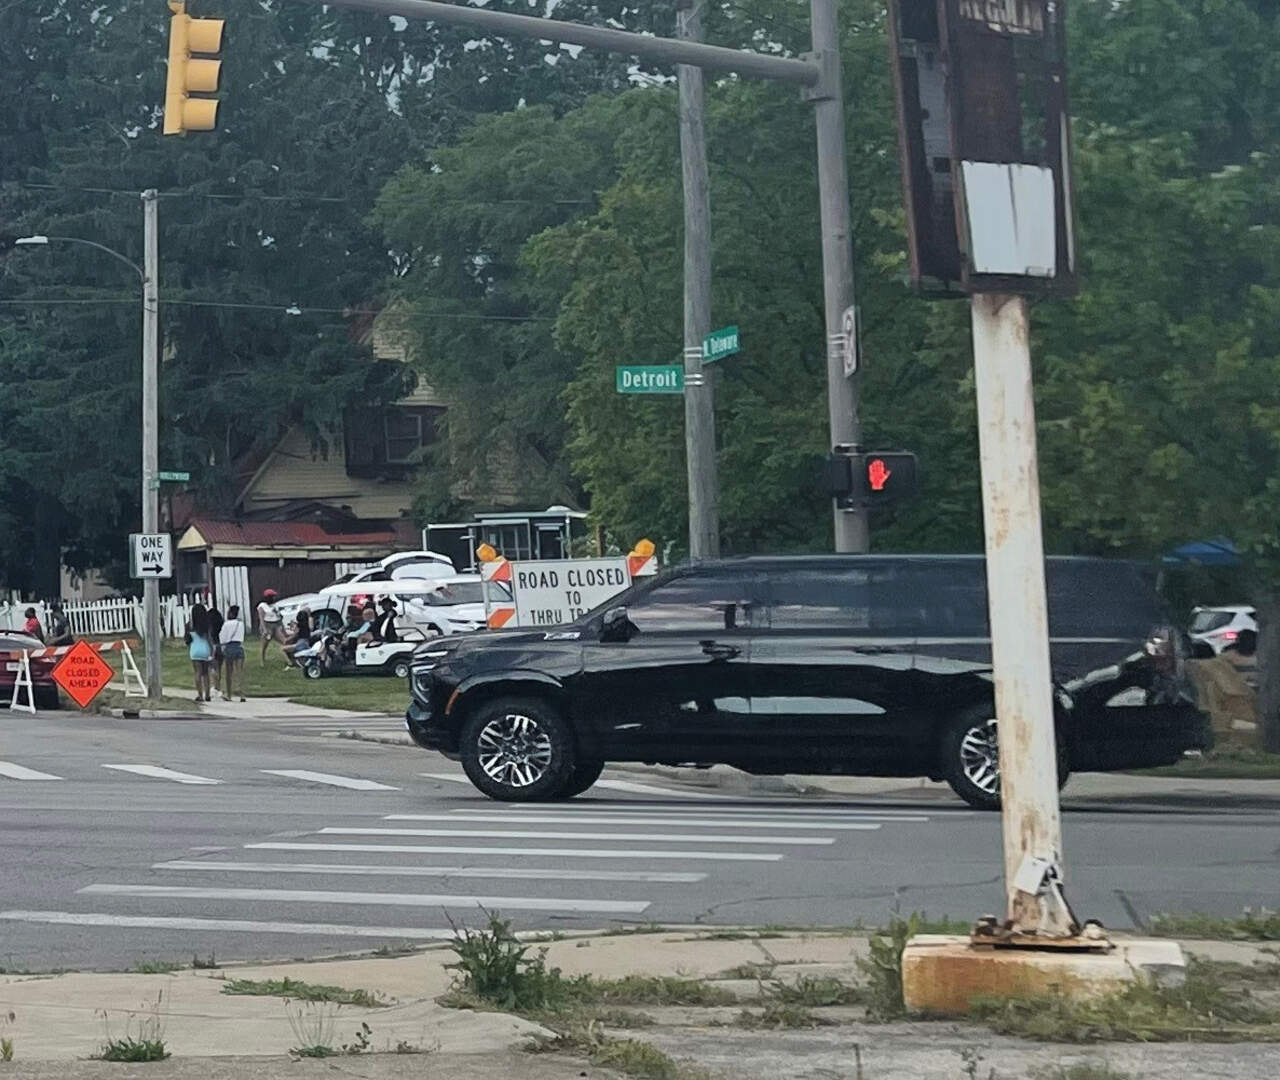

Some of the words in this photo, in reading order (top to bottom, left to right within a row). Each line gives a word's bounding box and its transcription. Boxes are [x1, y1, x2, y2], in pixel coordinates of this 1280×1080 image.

[623, 370, 677, 387] Detroit
[141, 537, 164, 548] ONE
[142, 552, 164, 563] WAY
[519, 570, 559, 589] ROAD
[567, 568, 624, 587] CLOSED
[566, 591, 581, 605] TO
[530, 609, 562, 625] THRU
[70, 656, 95, 664] ROAD
[65, 668, 100, 677] CLOSED
[69, 680, 98, 688] AHEAD
